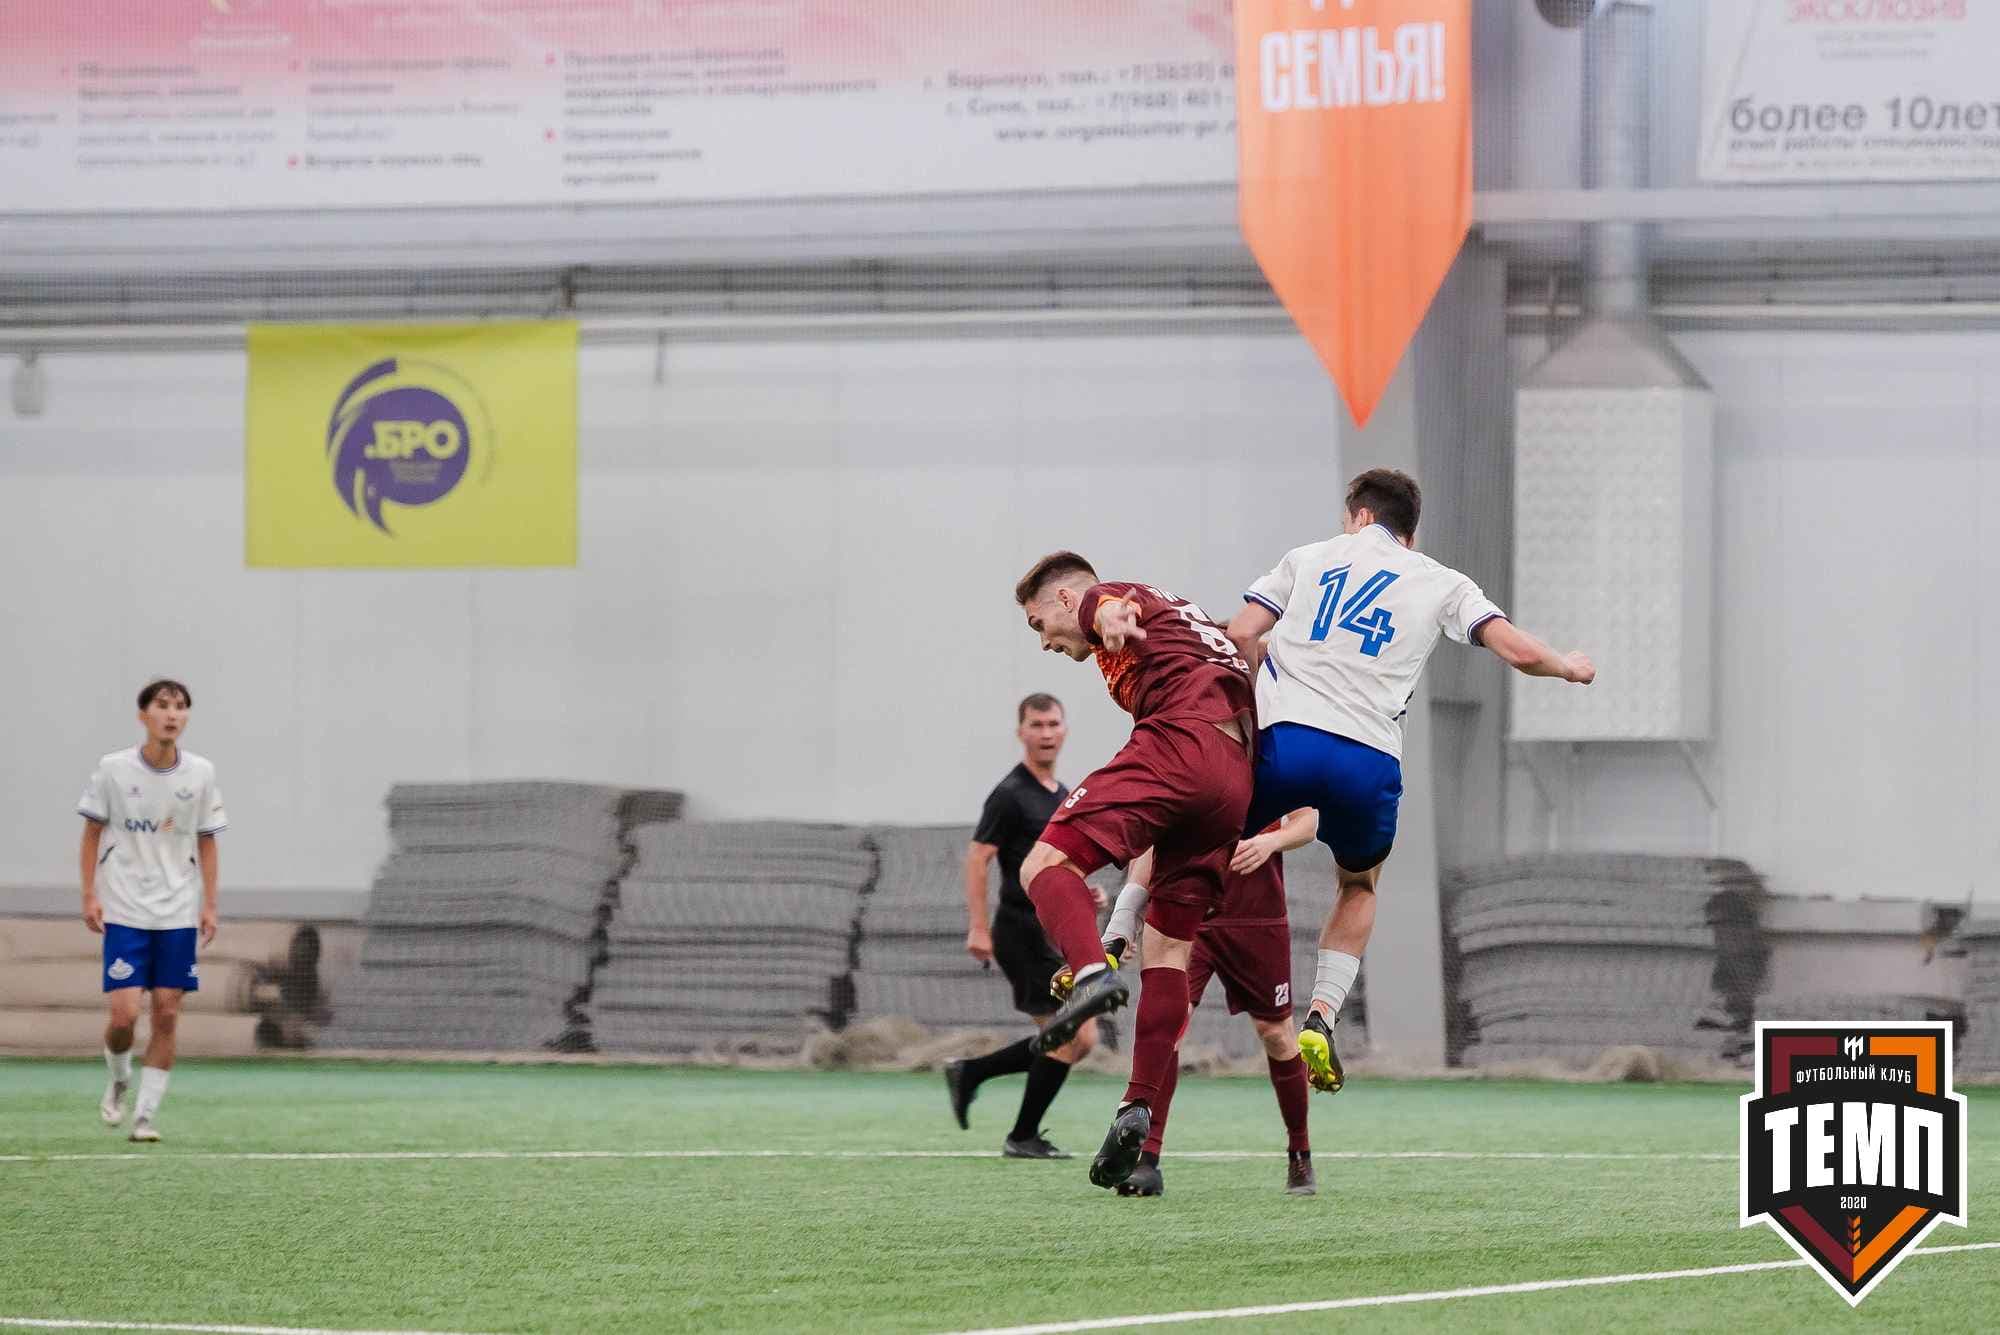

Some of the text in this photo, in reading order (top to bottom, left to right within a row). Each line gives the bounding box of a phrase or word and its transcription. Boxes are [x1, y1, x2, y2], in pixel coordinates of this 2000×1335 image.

[1260, 22, 1446, 112] СЕМЬЯ!
[1730, 94, 1867, 133] более
[1309, 562, 1400, 658] 14
